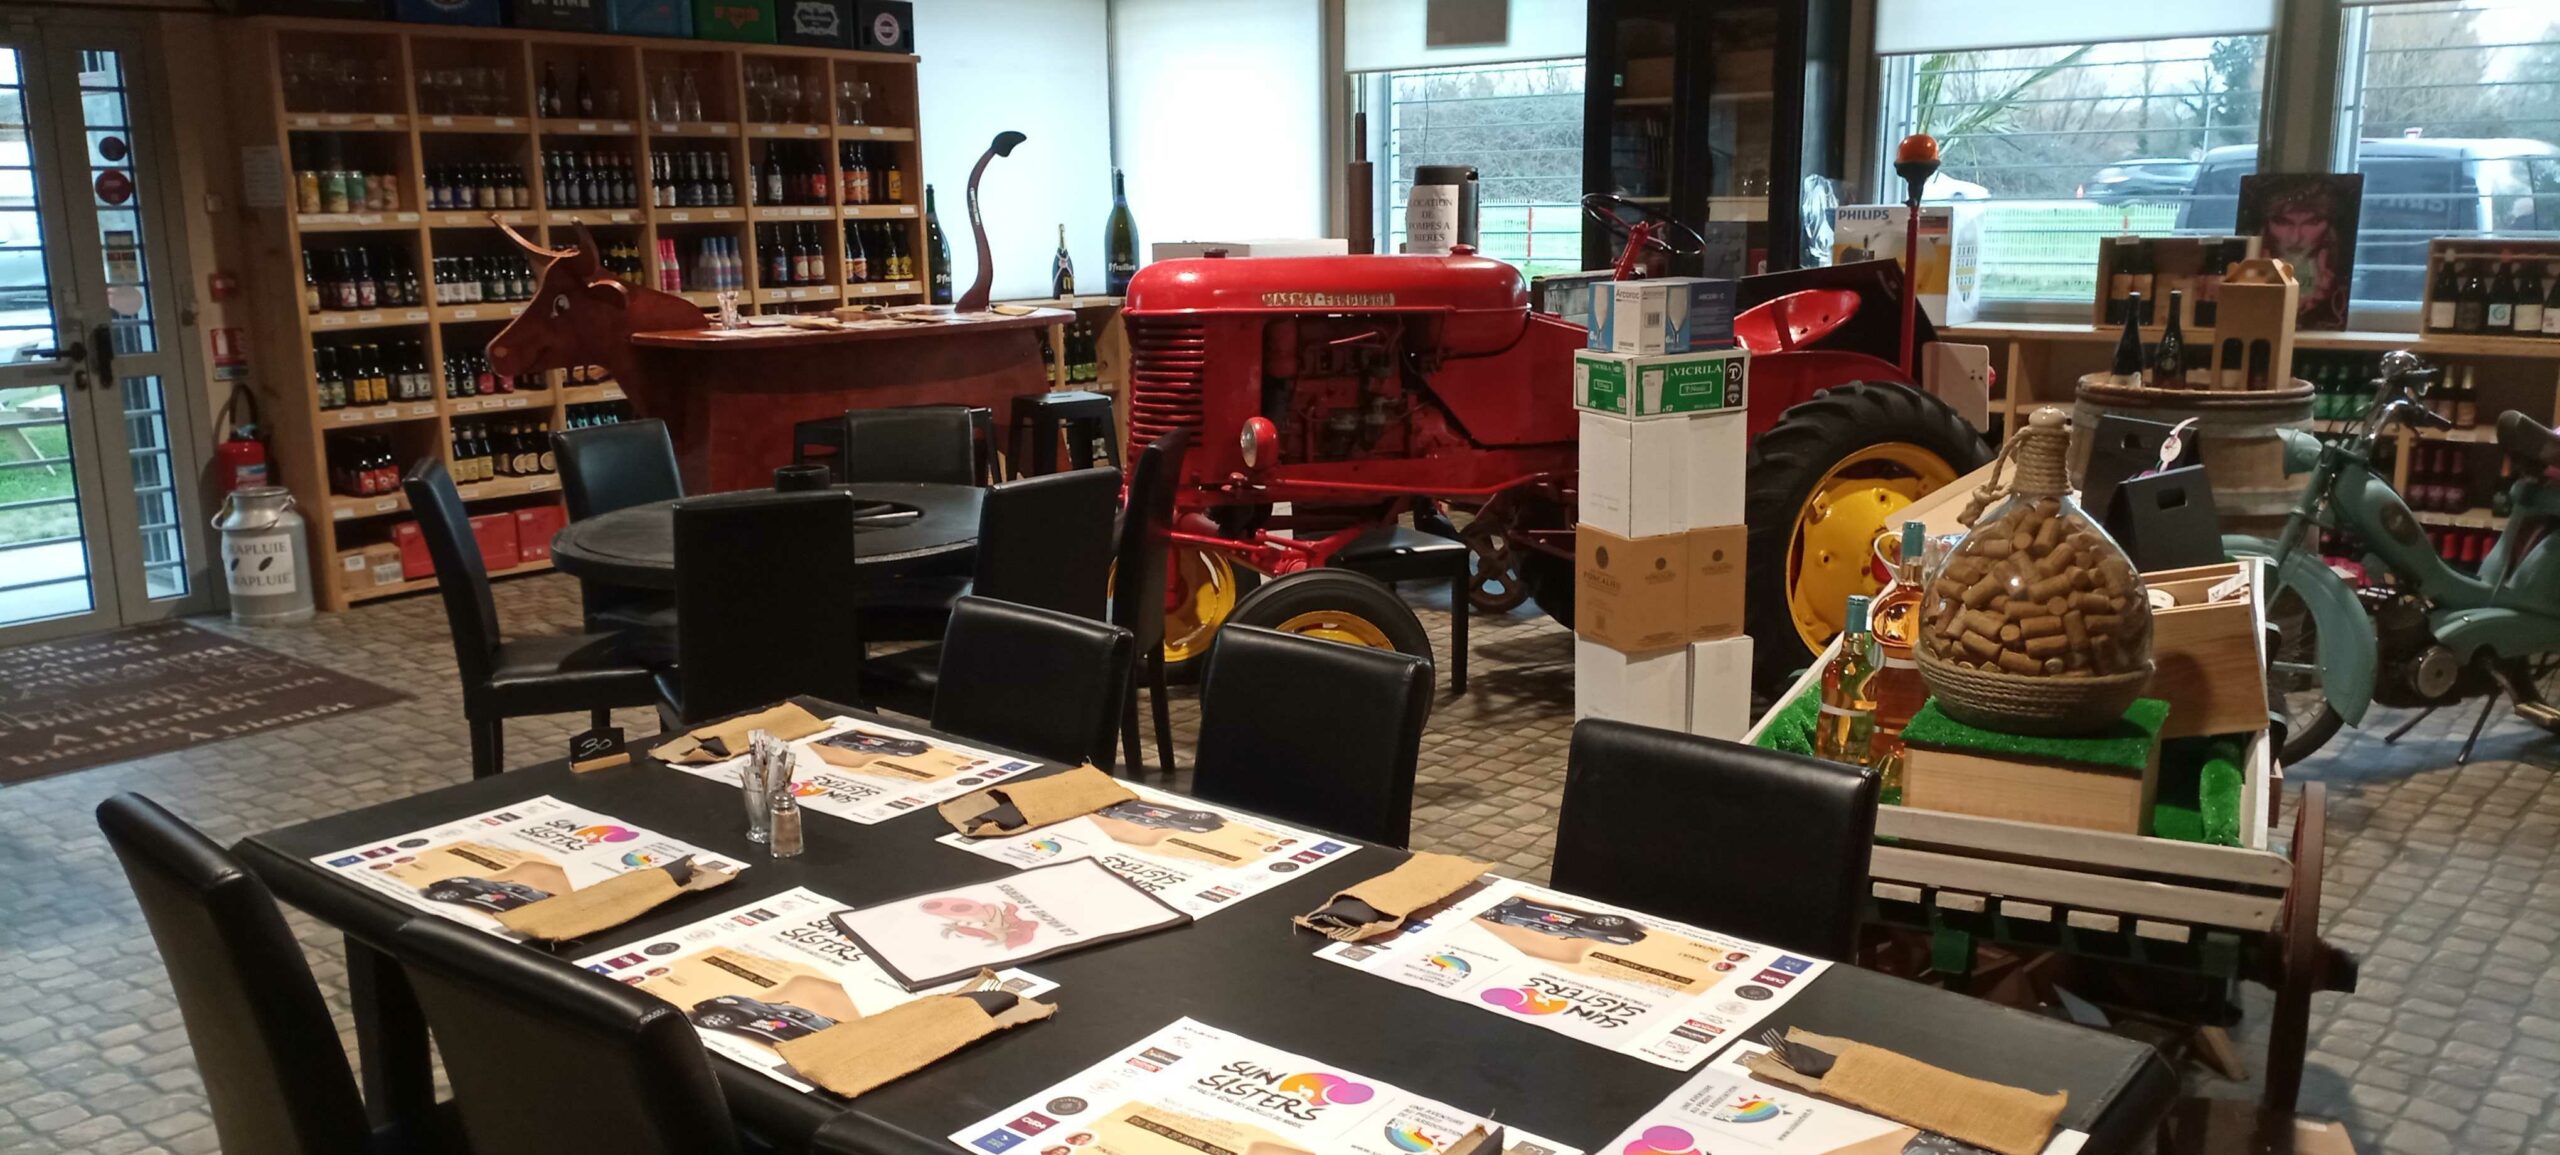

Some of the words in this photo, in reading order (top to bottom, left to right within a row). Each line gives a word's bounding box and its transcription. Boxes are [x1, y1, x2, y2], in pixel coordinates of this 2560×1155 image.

[1838, 209, 1889, 220] PHILIPS
[1616, 289, 1640, 300] Arcoroc
[1673, 364, 1722, 376] VICRILA
[579, 737, 612, 758] 30
[810, 775, 881, 797] SISTERS
[822, 790, 861, 804] SUN
[545, 819, 588, 833] SUN
[519, 826, 594, 851] SISTERS
[1101, 856, 1186, 885] SISTERS
[780, 928, 868, 963] SISTERS
[1519, 977, 1646, 1017] SISTERS
[1562, 1005, 1628, 1029] SUN
[1221, 1061, 1289, 1085] SUN
[1197, 1074, 1326, 1121] SISTERS
